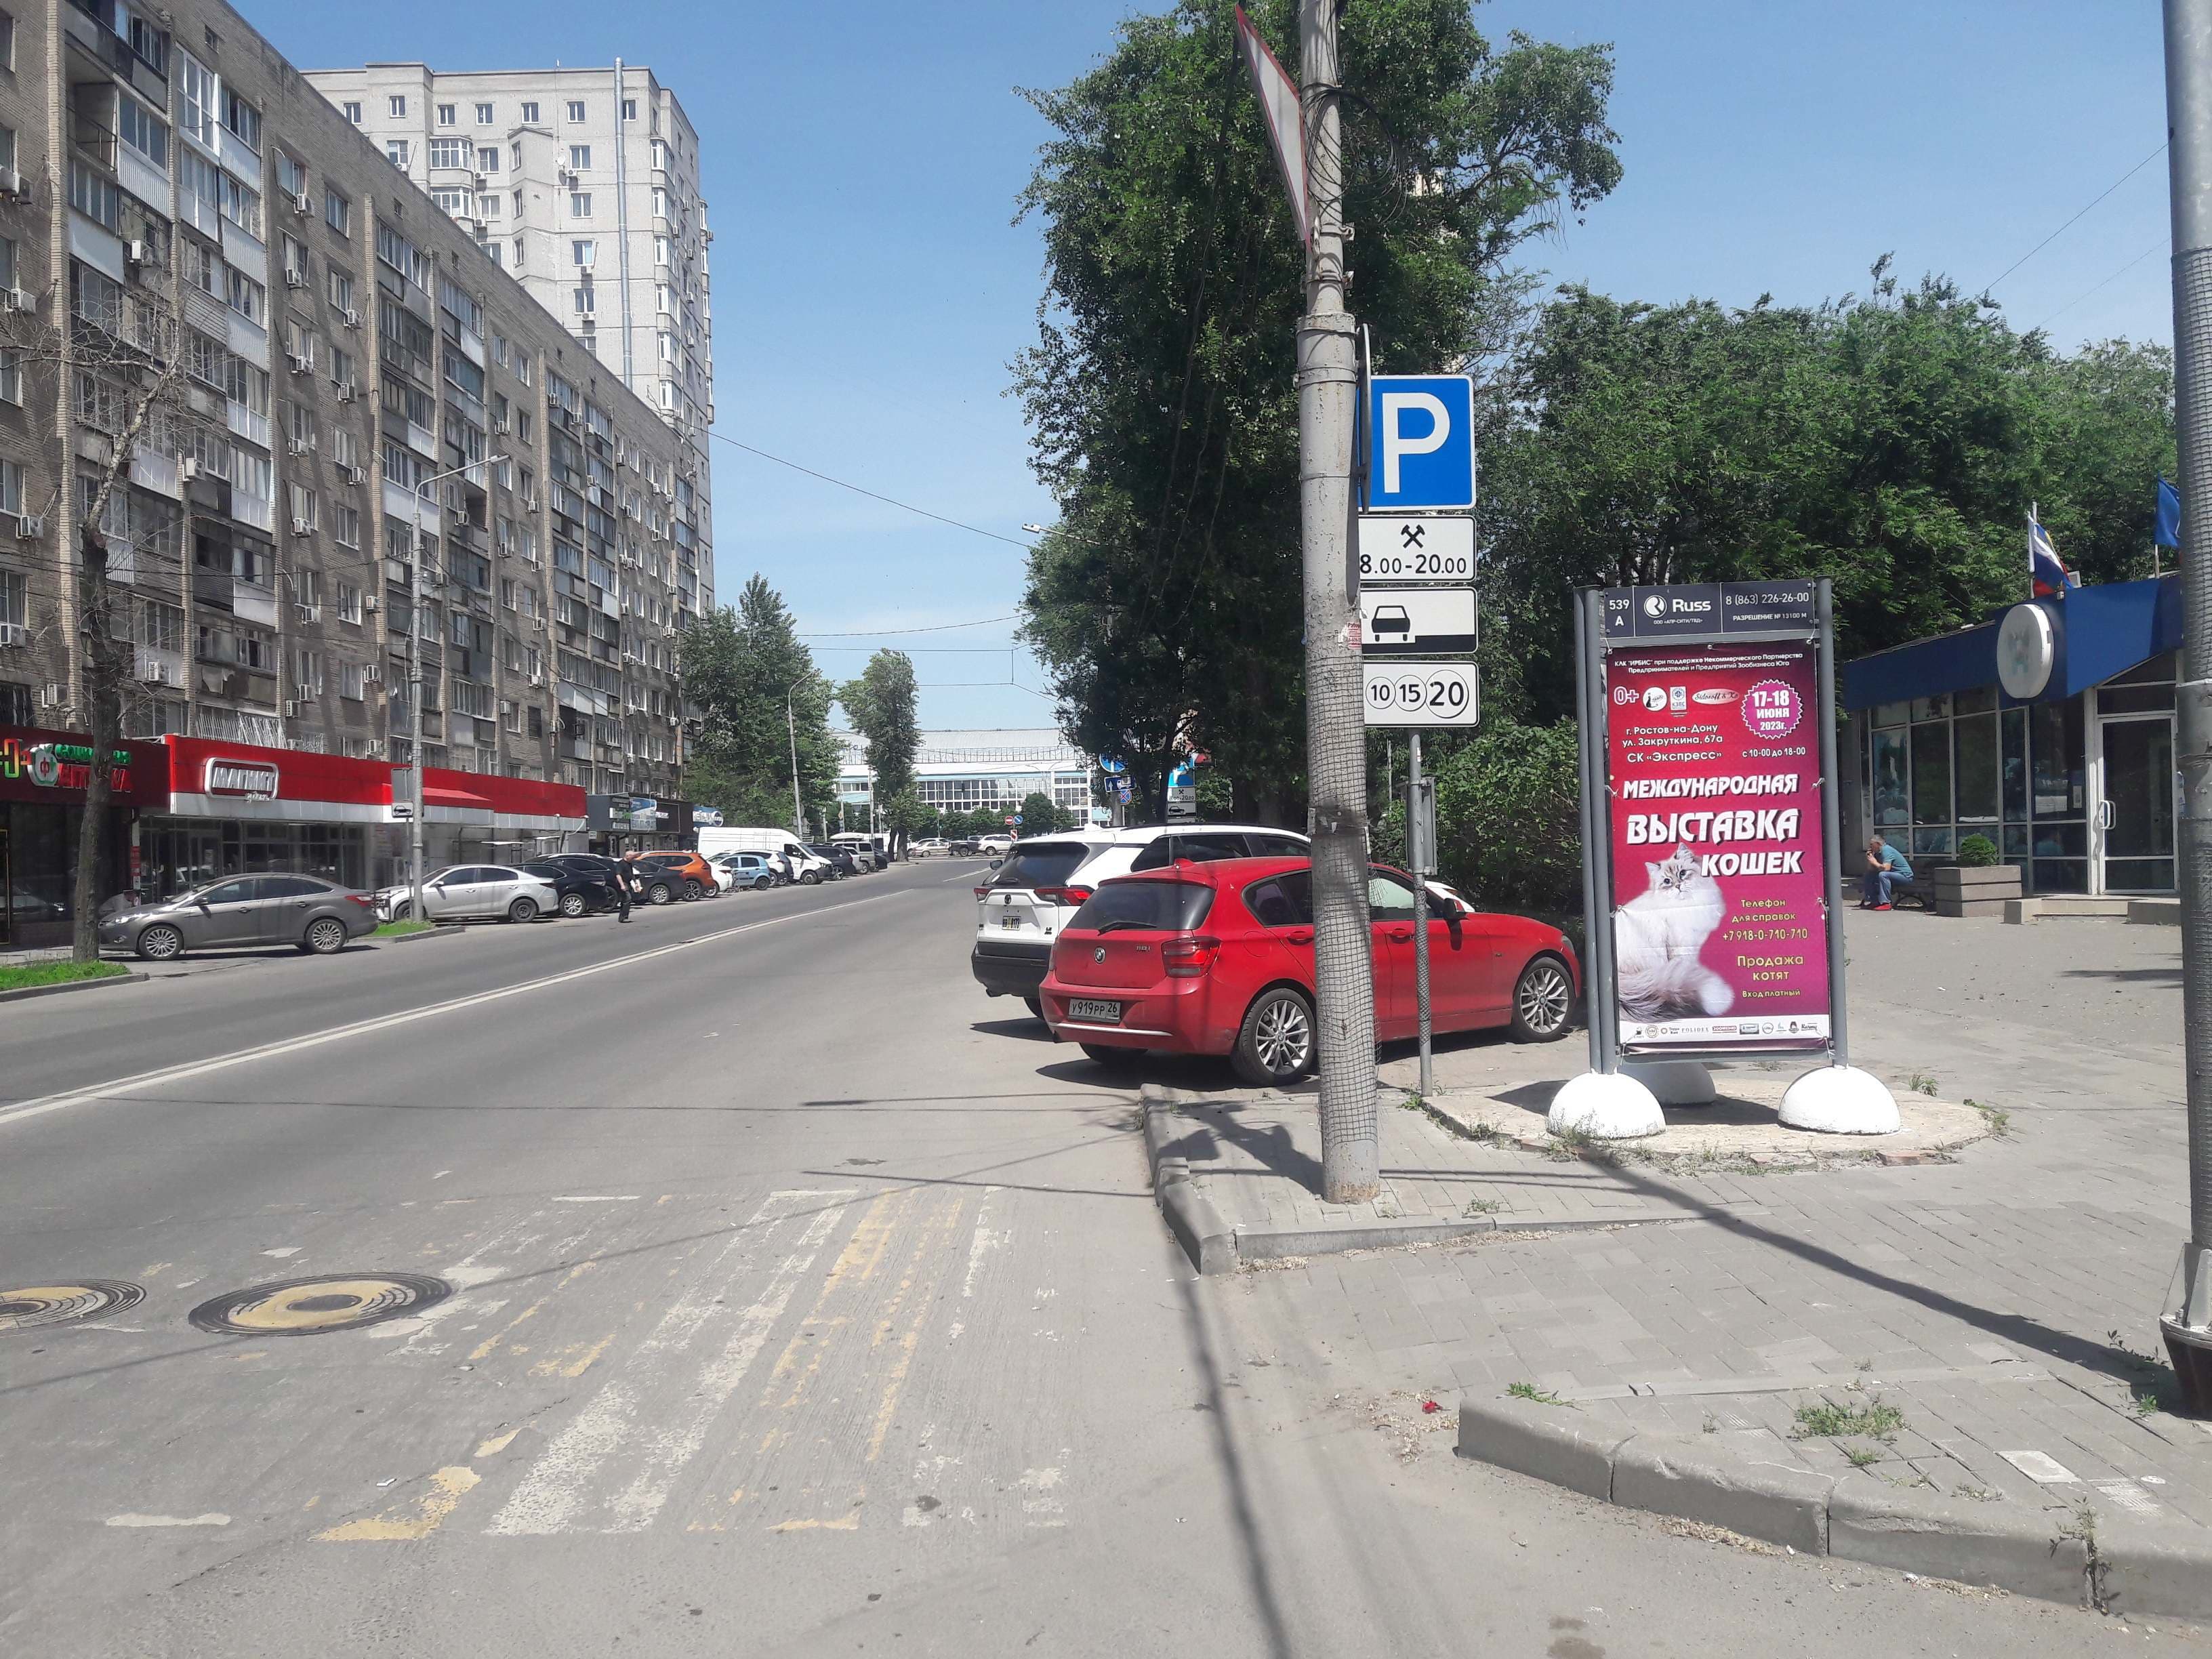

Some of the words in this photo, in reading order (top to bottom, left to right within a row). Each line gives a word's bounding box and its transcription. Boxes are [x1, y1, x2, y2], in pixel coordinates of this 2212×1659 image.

[1382, 392, 1450, 493] P
[1359, 554, 1467, 574] 8.00-20.00
[1609, 599, 1630, 610] 539
[1725, 596, 1732, 605] 8
[1735, 594, 1759, 606] (863)
[1762, 592, 1809, 603] 226-26-00
[1673, 599, 1712, 613] Russ
[1615, 615, 1624, 626] А
[1666, 657, 1703, 665] поддержке
[1704, 655, 1762, 663] Некоммерческого
[1629, 665, 1689, 674] Предпринимателей
[1696, 663, 1737, 671] Предприятий
[1738, 661, 1775, 669] Зообизнеса
[1371, 684, 1389, 701] 10
[1399, 684, 1420, 703] 15
[1429, 681, 1464, 706] 20
[1614, 686, 1639, 705] 0+
[1752, 690, 1790, 707] 17-18
[1634, 724, 1719, 735] Ростов-на-Дону
[1760, 721, 1787, 731] 2023г.
[1622, 739, 1636, 748] ул.
[1638, 735, 1702, 746] Закруткина,
[1704, 735, 1723, 743] 67а
[1627, 753, 1644, 762] СК
[1646, 752, 1722, 762] «Экспресс»
[1749, 748, 1771, 758] 10-00
[1784, 747, 1806, 756] 18-00
[213, 766, 274, 792] МАГНИТ
[1623, 774, 1798, 799] МЕЖДУНАРОДНАЯ
[1626, 808, 1799, 845] ВЫСТАВКА
[1701, 851, 1803, 876] КОШЕК
[1741, 899, 1786, 908] Телефон
[1732, 915, 1750, 924] для
[1753, 914, 1796, 922] справок
[1737, 956, 1804, 968] Продажа
[1742, 990, 1763, 998] Вход
[1765, 989, 1801, 998] платный
[1107, 1002, 1118, 1013] 26
